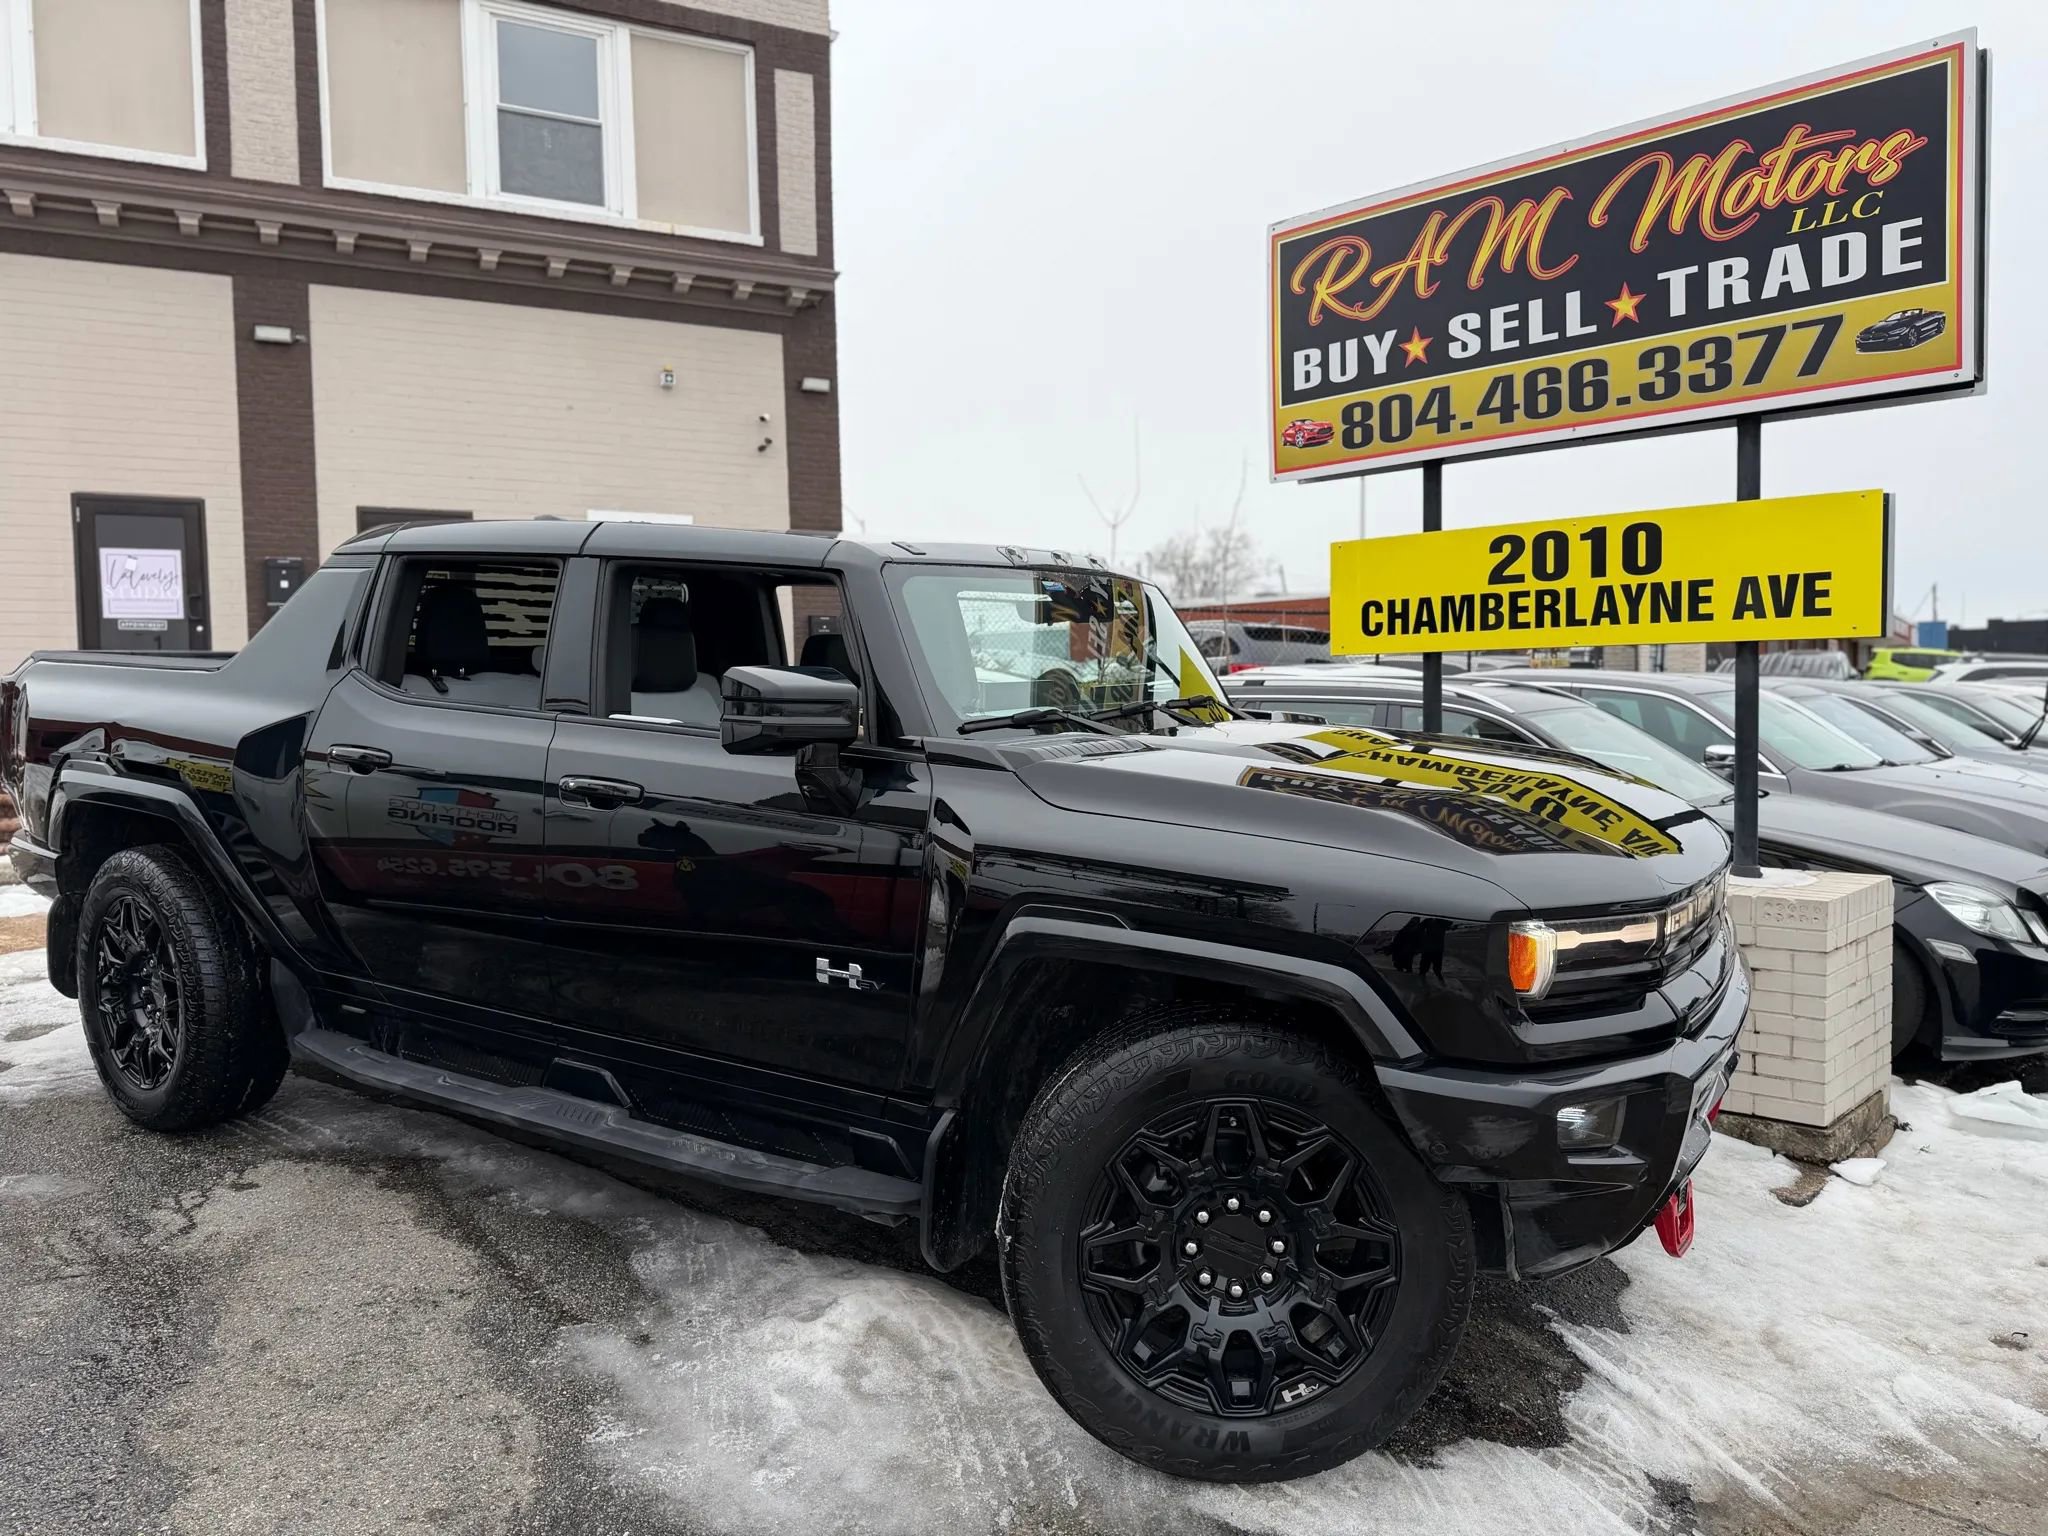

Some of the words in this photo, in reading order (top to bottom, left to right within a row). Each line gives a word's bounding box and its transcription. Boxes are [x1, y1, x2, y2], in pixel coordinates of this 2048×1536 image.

[1588, 123, 1928, 253] Motors
[1786, 191, 1884, 234] LLC
[1293, 329, 1398, 391] BUY
[1448, 291, 1597, 359] SELL
[1657, 217, 1924, 317] TRADE
[1340, 315, 1844, 452] 804.466.3377
[1487, 522, 1663, 585] 2010
[1361, 579, 1714, 638] CHAMBERLAYNE
[1732, 572, 1833, 621] AVE
